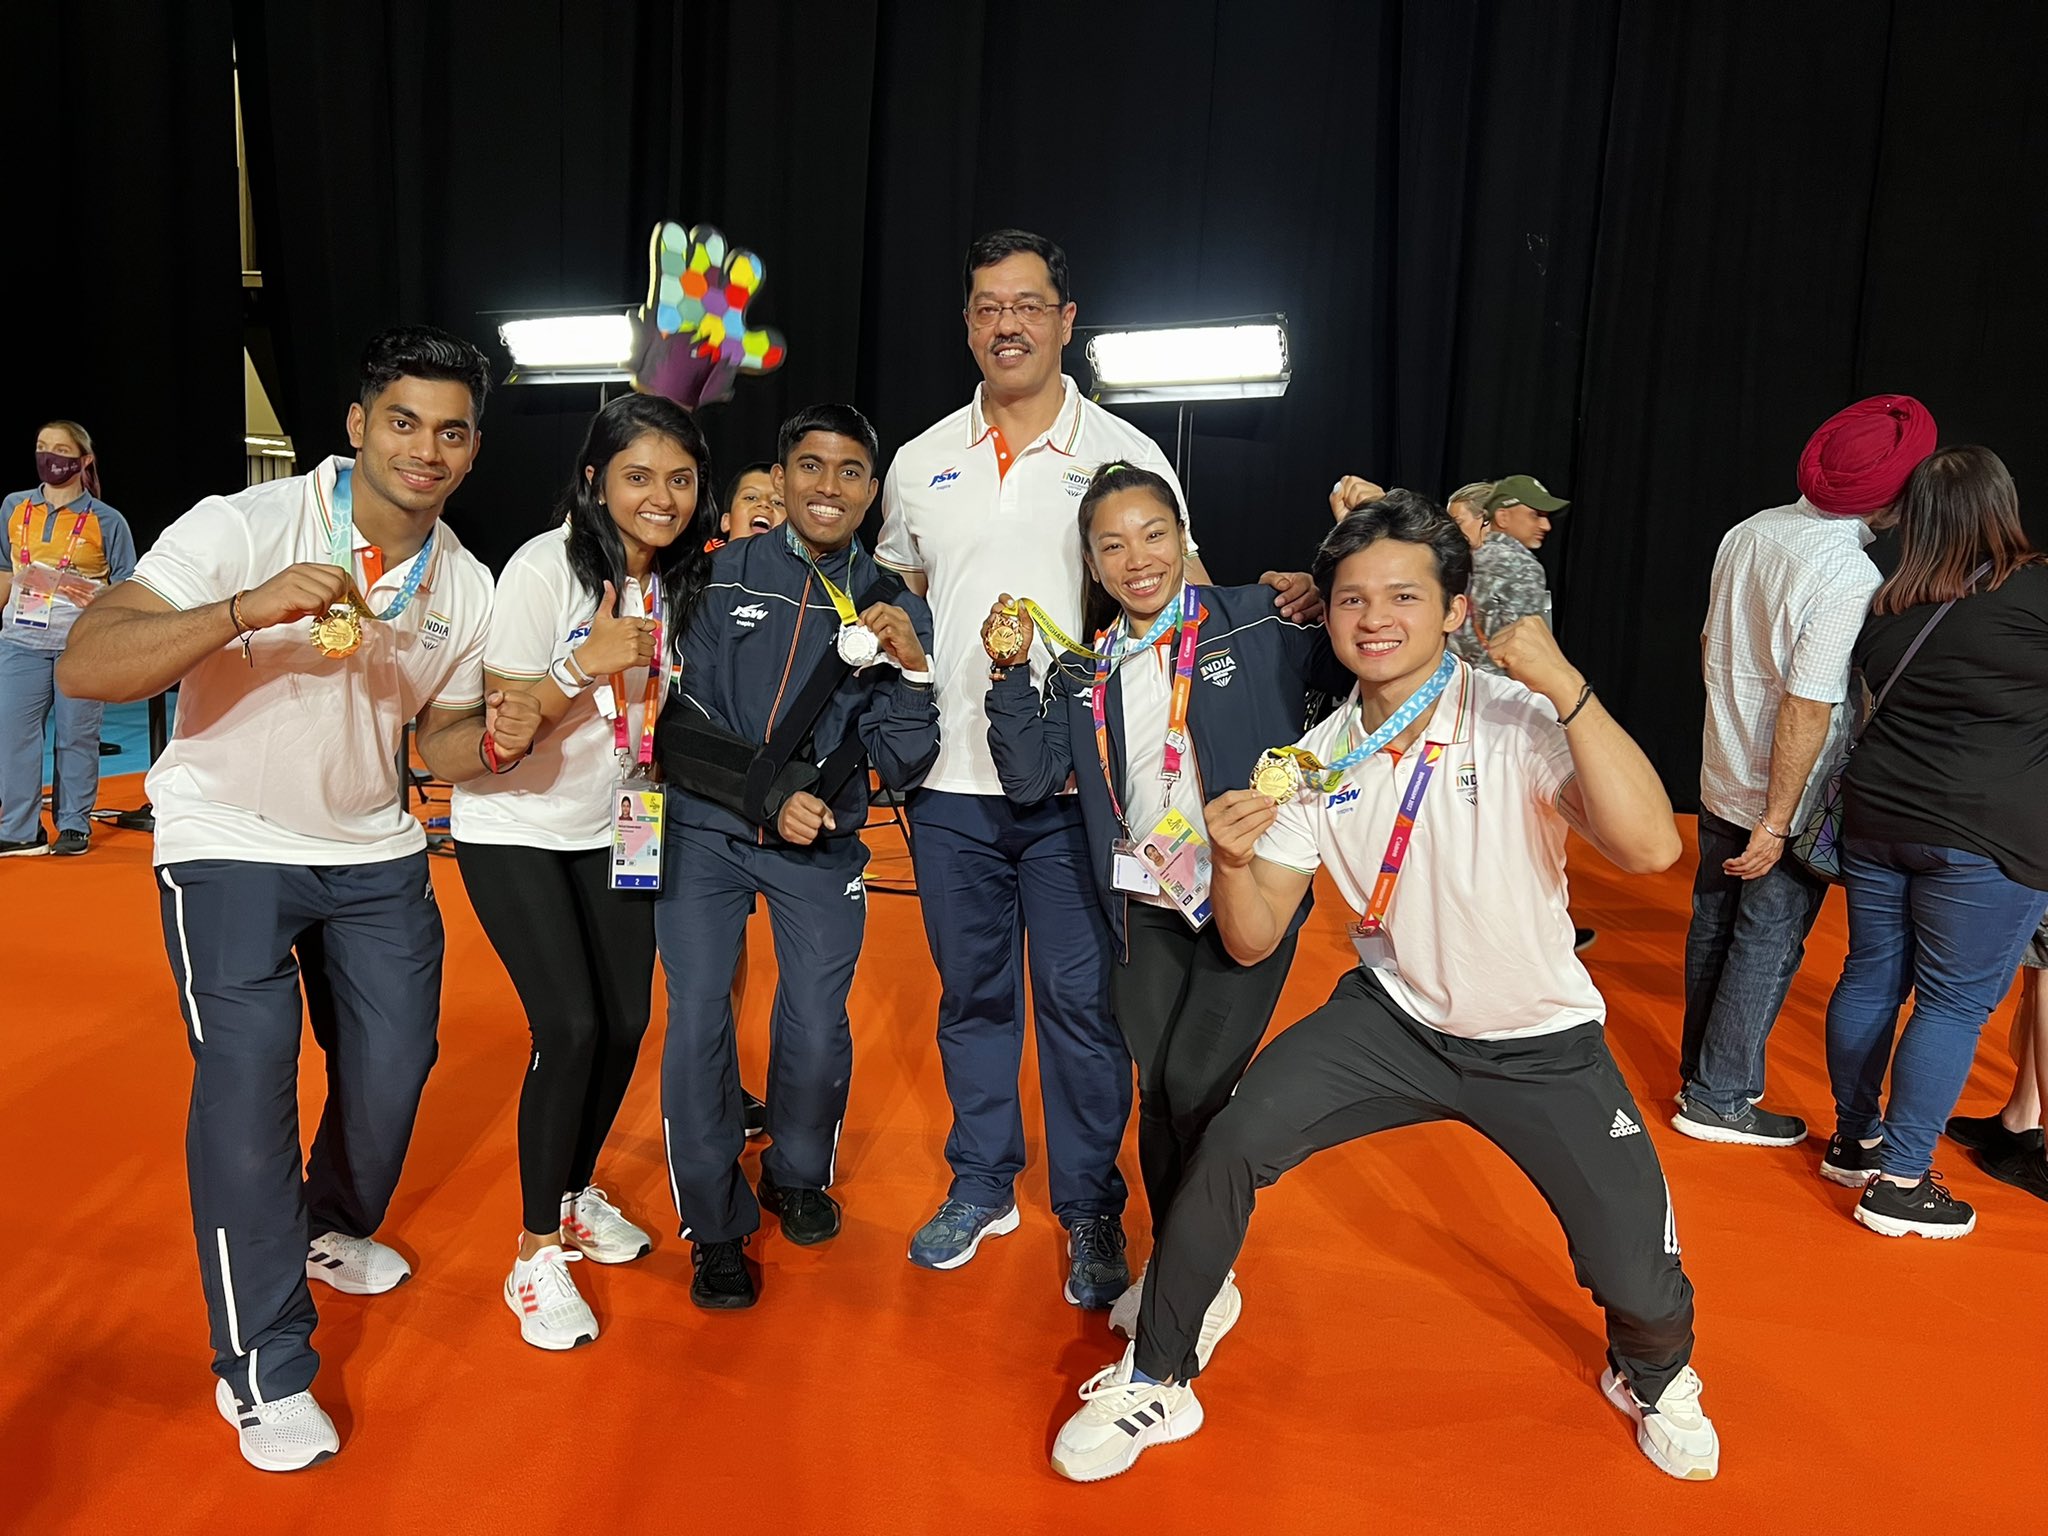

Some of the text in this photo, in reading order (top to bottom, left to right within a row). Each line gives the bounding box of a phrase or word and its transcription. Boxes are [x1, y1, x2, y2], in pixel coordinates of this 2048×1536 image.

[928, 469, 961, 488] JSW
[1062, 471, 1092, 486] INDIA
[729, 603, 769, 620] JSW
[1031, 605, 1067, 643] BIRMINGHAM
[1200, 655, 1236, 677] INDIA
[1456, 774, 1477, 787] IND
[1325, 788, 1361, 810] JSW
